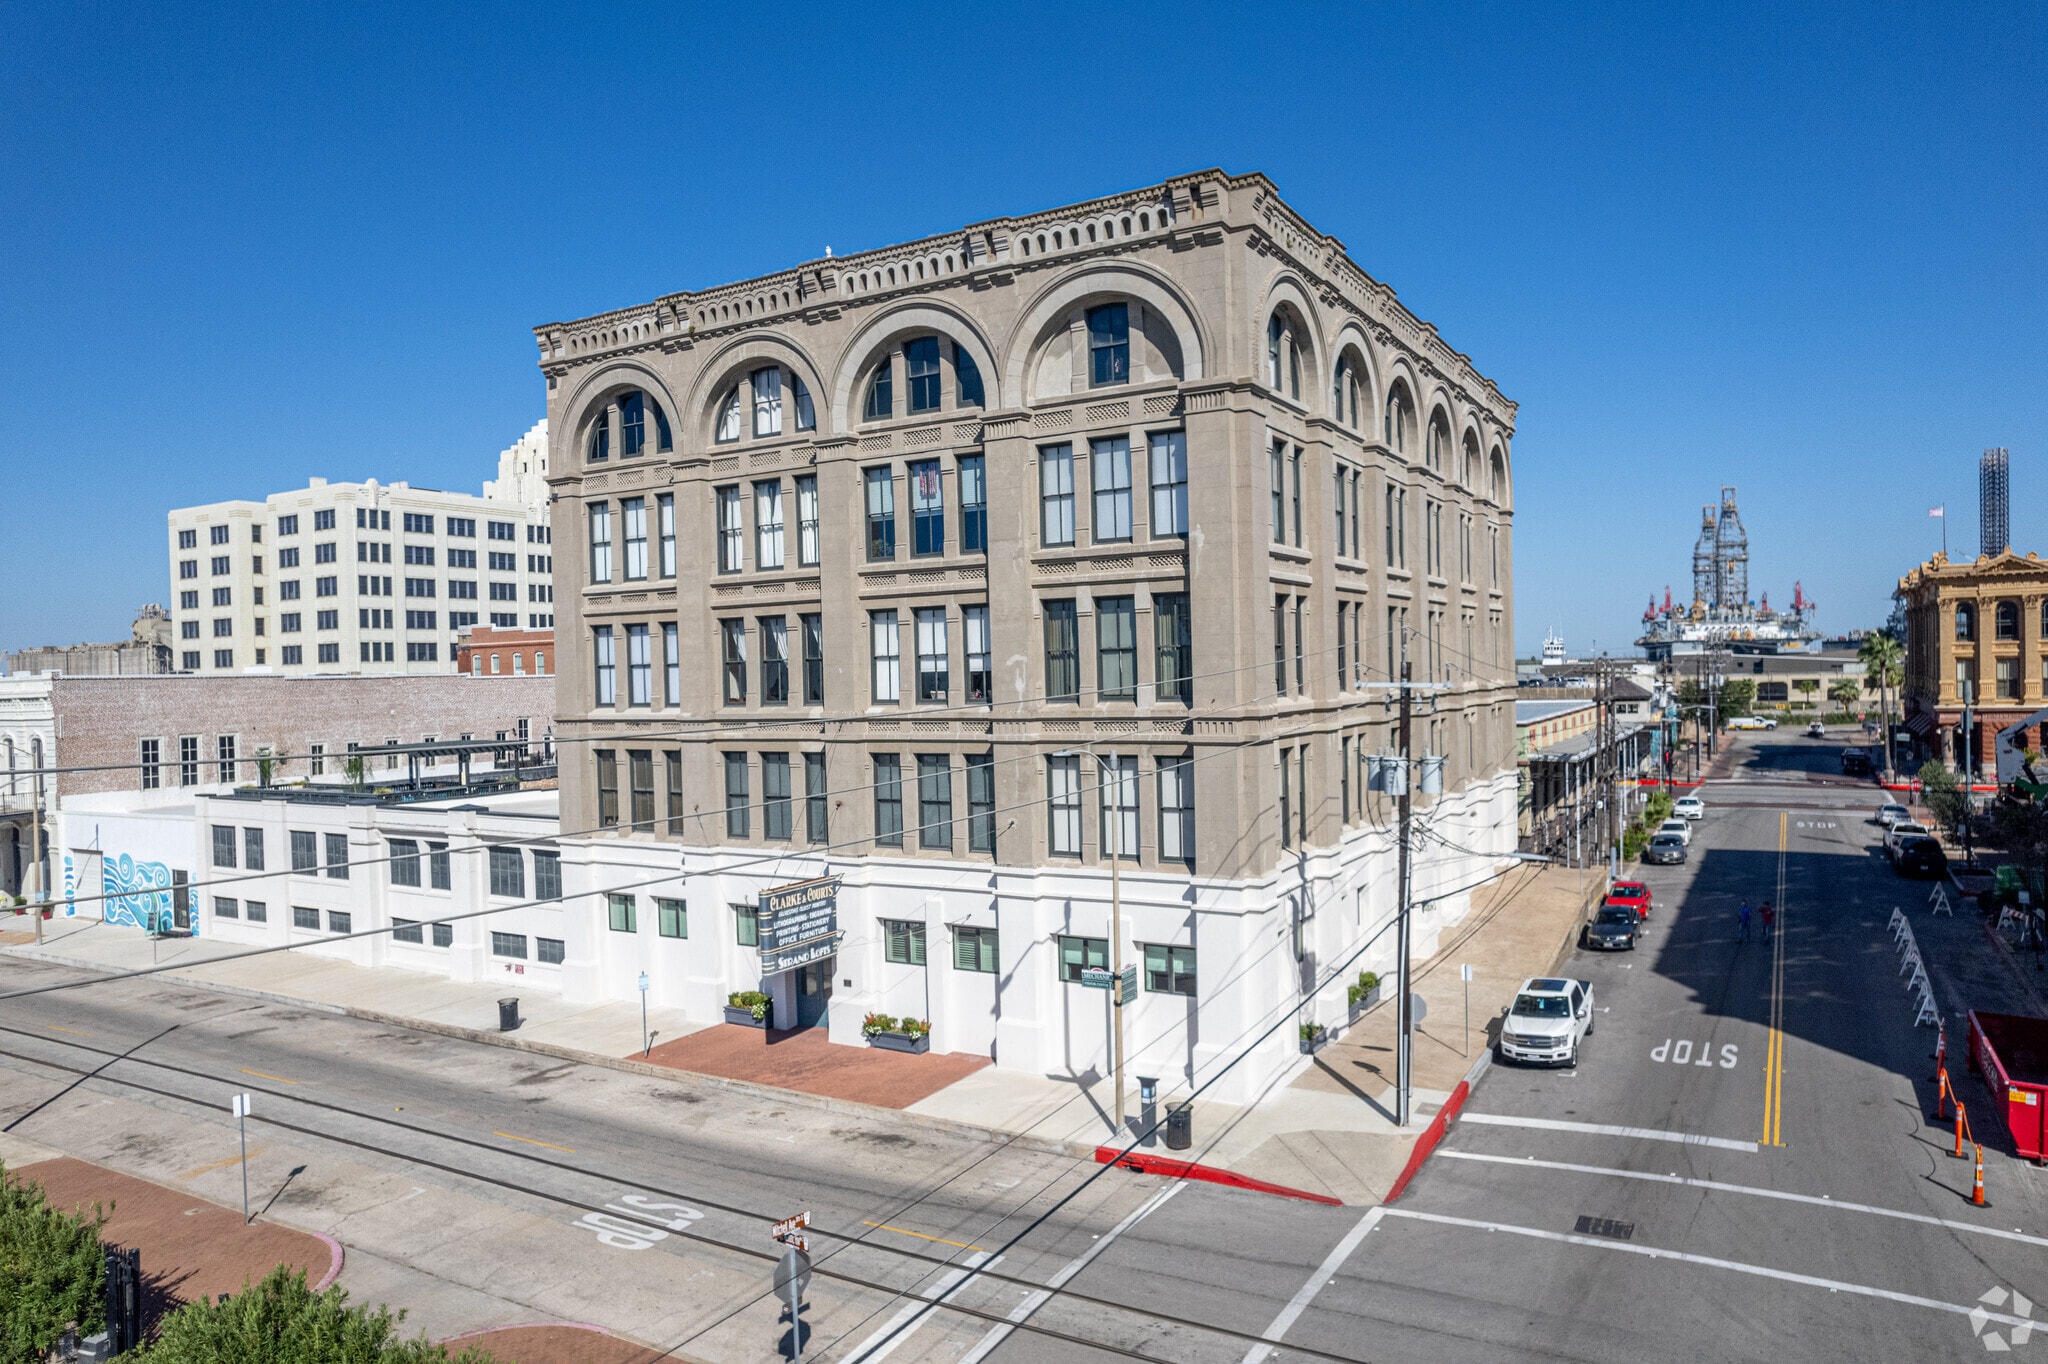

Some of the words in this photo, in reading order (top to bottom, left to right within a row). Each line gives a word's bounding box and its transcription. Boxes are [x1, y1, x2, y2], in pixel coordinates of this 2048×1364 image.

[1796, 821, 1836, 829] STOP
[770, 893, 801, 911] CLARKE
[807, 885, 834, 902] COURTS
[778, 934, 797, 946] OFFICE
[799, 925, 828, 940] FURNITURE
[778, 952, 810, 969] STRAND
[810, 945, 831, 960] LOFTS
[1649, 1039, 1739, 1069] STOP
[572, 1195, 705, 1250] STOP
